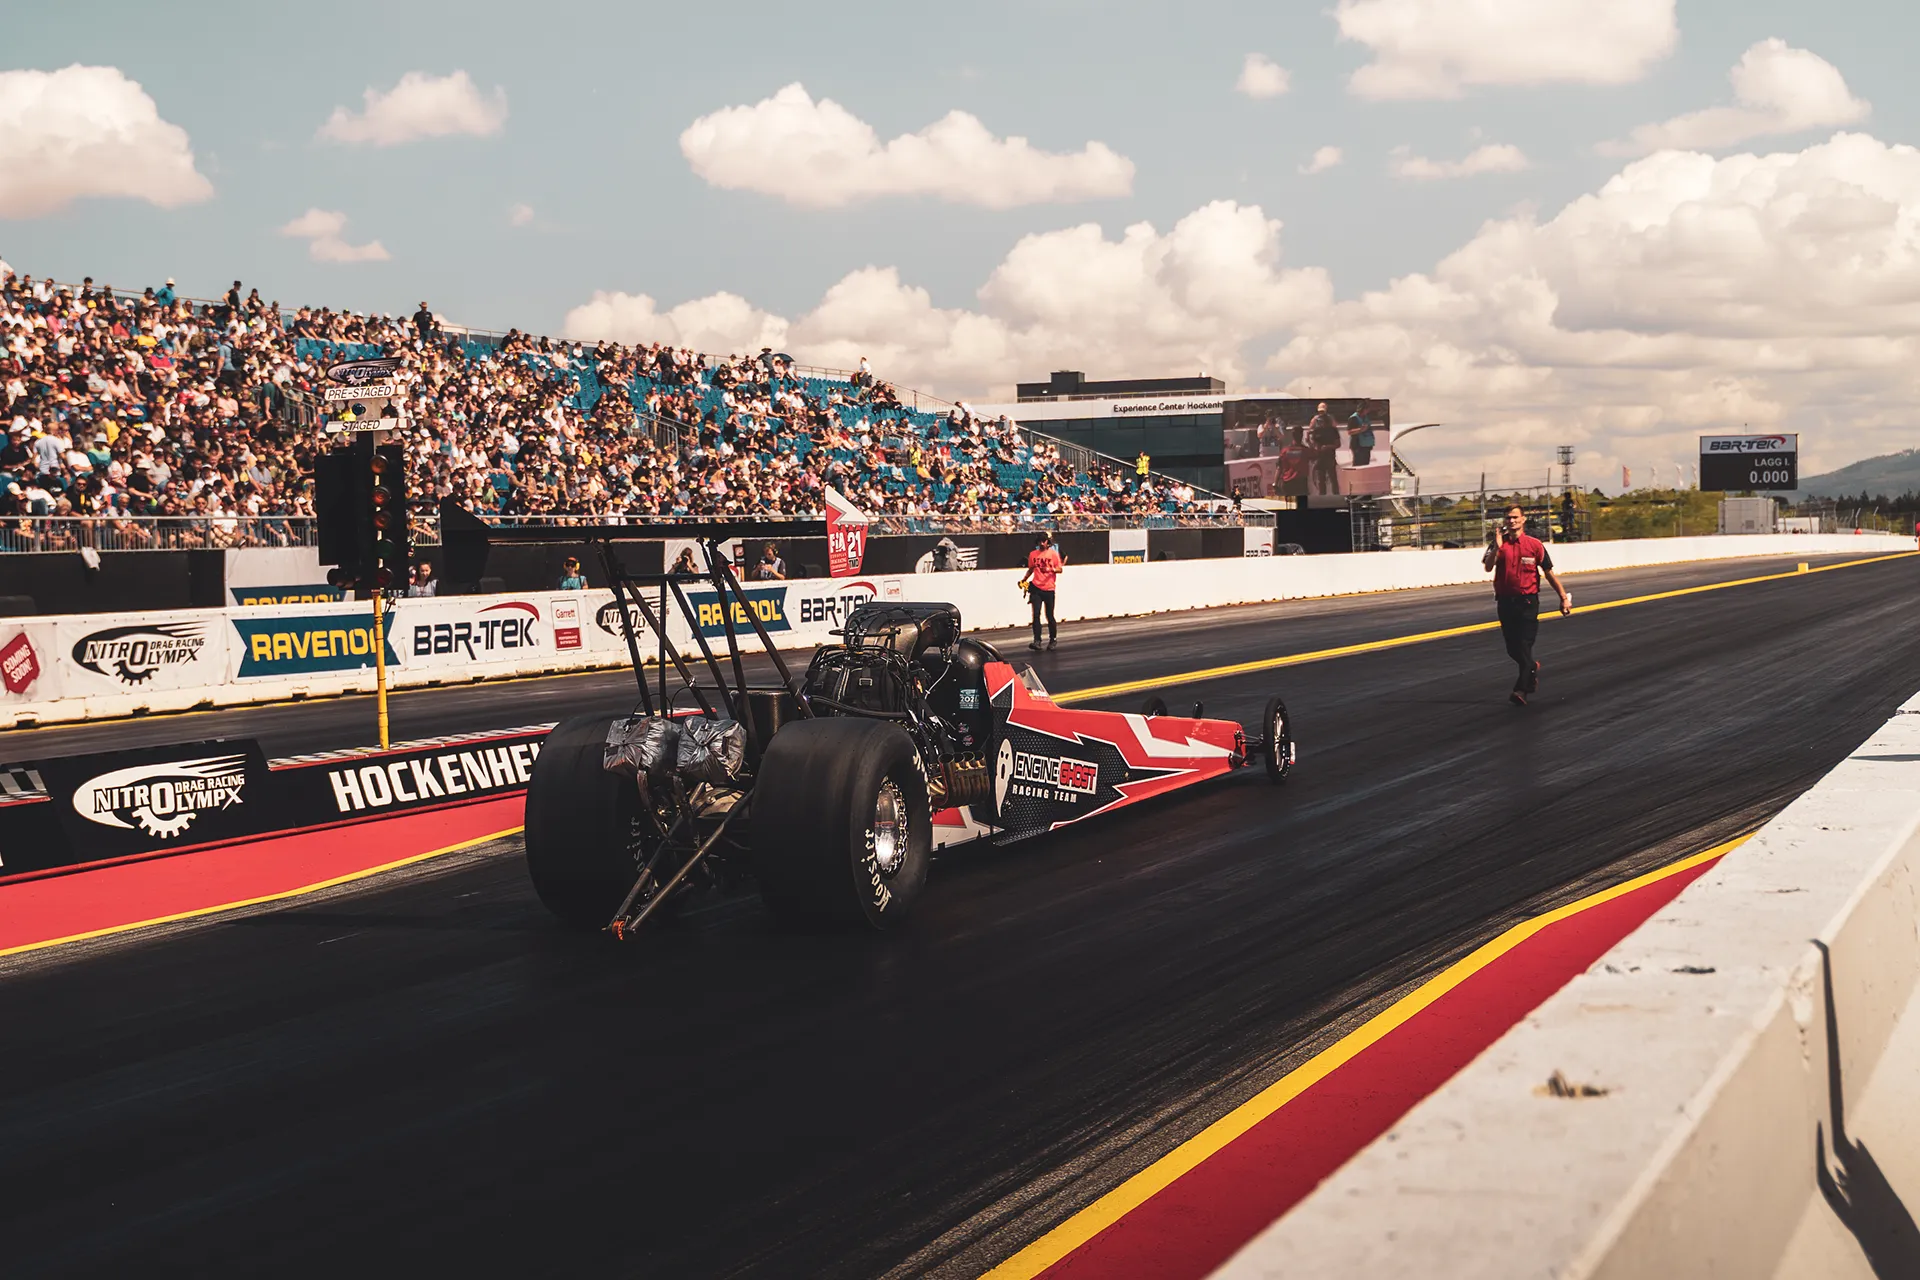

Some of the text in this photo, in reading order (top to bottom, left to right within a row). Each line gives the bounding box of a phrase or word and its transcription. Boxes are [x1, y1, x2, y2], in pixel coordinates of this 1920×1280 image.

[328, 386, 391, 399] PRE-STAGED
[1113, 404, 1157, 414] Experience
[1159, 402, 1185, 411] Center
[341, 420, 380, 431] STAGED
[1755, 458, 1782, 467] LAGG
[1750, 470, 1789, 484] 0.000
[830, 532, 846, 553] FIA
[847, 531, 862, 558] 21
[555, 608, 576, 619] Garrett
[150, 637, 205, 649] DRAG RACING
[3, 644, 32, 674] COMING
[11, 658, 34, 684] SOON!
[1014, 752, 1097, 791] ENGINE GHOST
[174, 774, 245, 794] DRAG RACING
[1012, 784, 1077, 803] RACING TEAM
